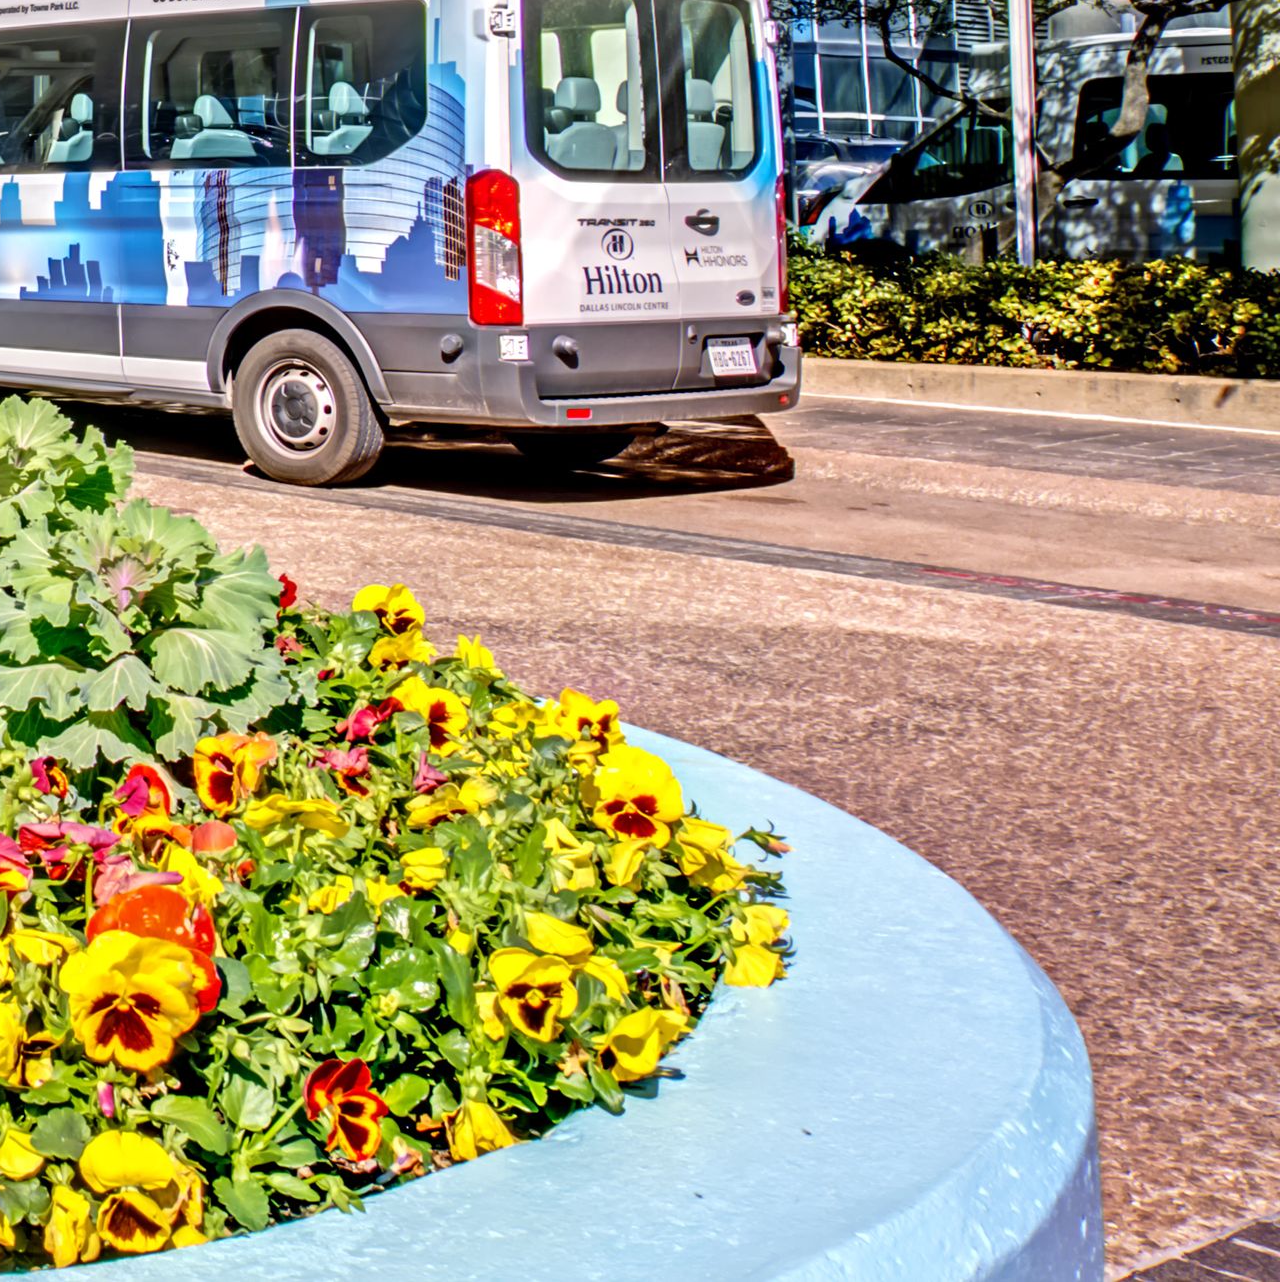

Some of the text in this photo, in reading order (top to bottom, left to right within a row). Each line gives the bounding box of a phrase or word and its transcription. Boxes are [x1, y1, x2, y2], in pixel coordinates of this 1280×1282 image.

[21, 5, 29, 14] by
[50, 2, 64, 11] Park
[577, 218, 638, 227] TRANSIT
[700, 245, 723, 254] HILTON
[582, 265, 663, 295] Hilton
[579, 301, 669, 312] DALLAS LINCOLN CENTRE
